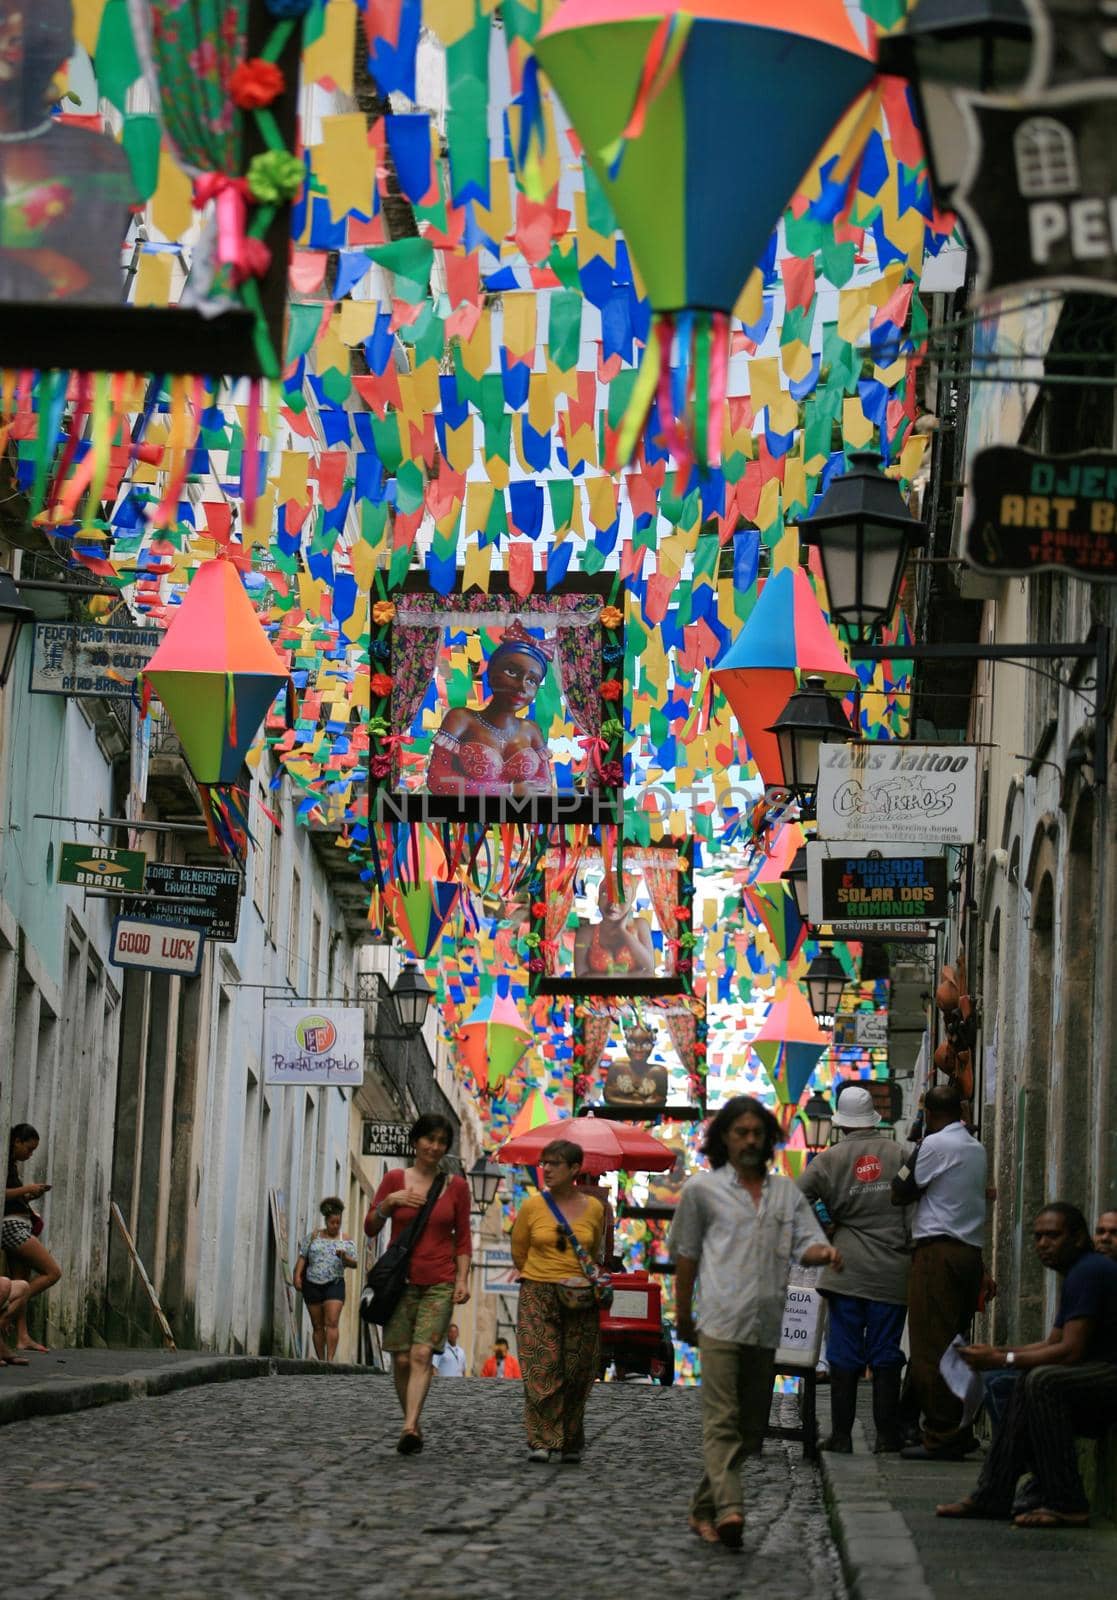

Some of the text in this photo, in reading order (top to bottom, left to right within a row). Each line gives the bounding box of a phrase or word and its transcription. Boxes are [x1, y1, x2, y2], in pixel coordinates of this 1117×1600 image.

[1028, 197, 1117, 264] PE
[1000, 494, 1117, 534] ART B
[888, 751, 969, 773] Tattoo
[91, 847, 118, 860] ART
[846, 859, 925, 874] POUSADA
[76, 871, 125, 888] BRASIL
[842, 873, 929, 888] E HOSTEL
[837, 886, 935, 903] SOLAR DOS
[846, 901, 926, 916] ROMANOS
[876, 924, 891, 932] EM
[894, 924, 927, 933] GERAL
[118, 931, 196, 961] GOOD LUCK
[856, 1163, 881, 1174] OESTE
[783, 1327, 808, 1340] 1,00
